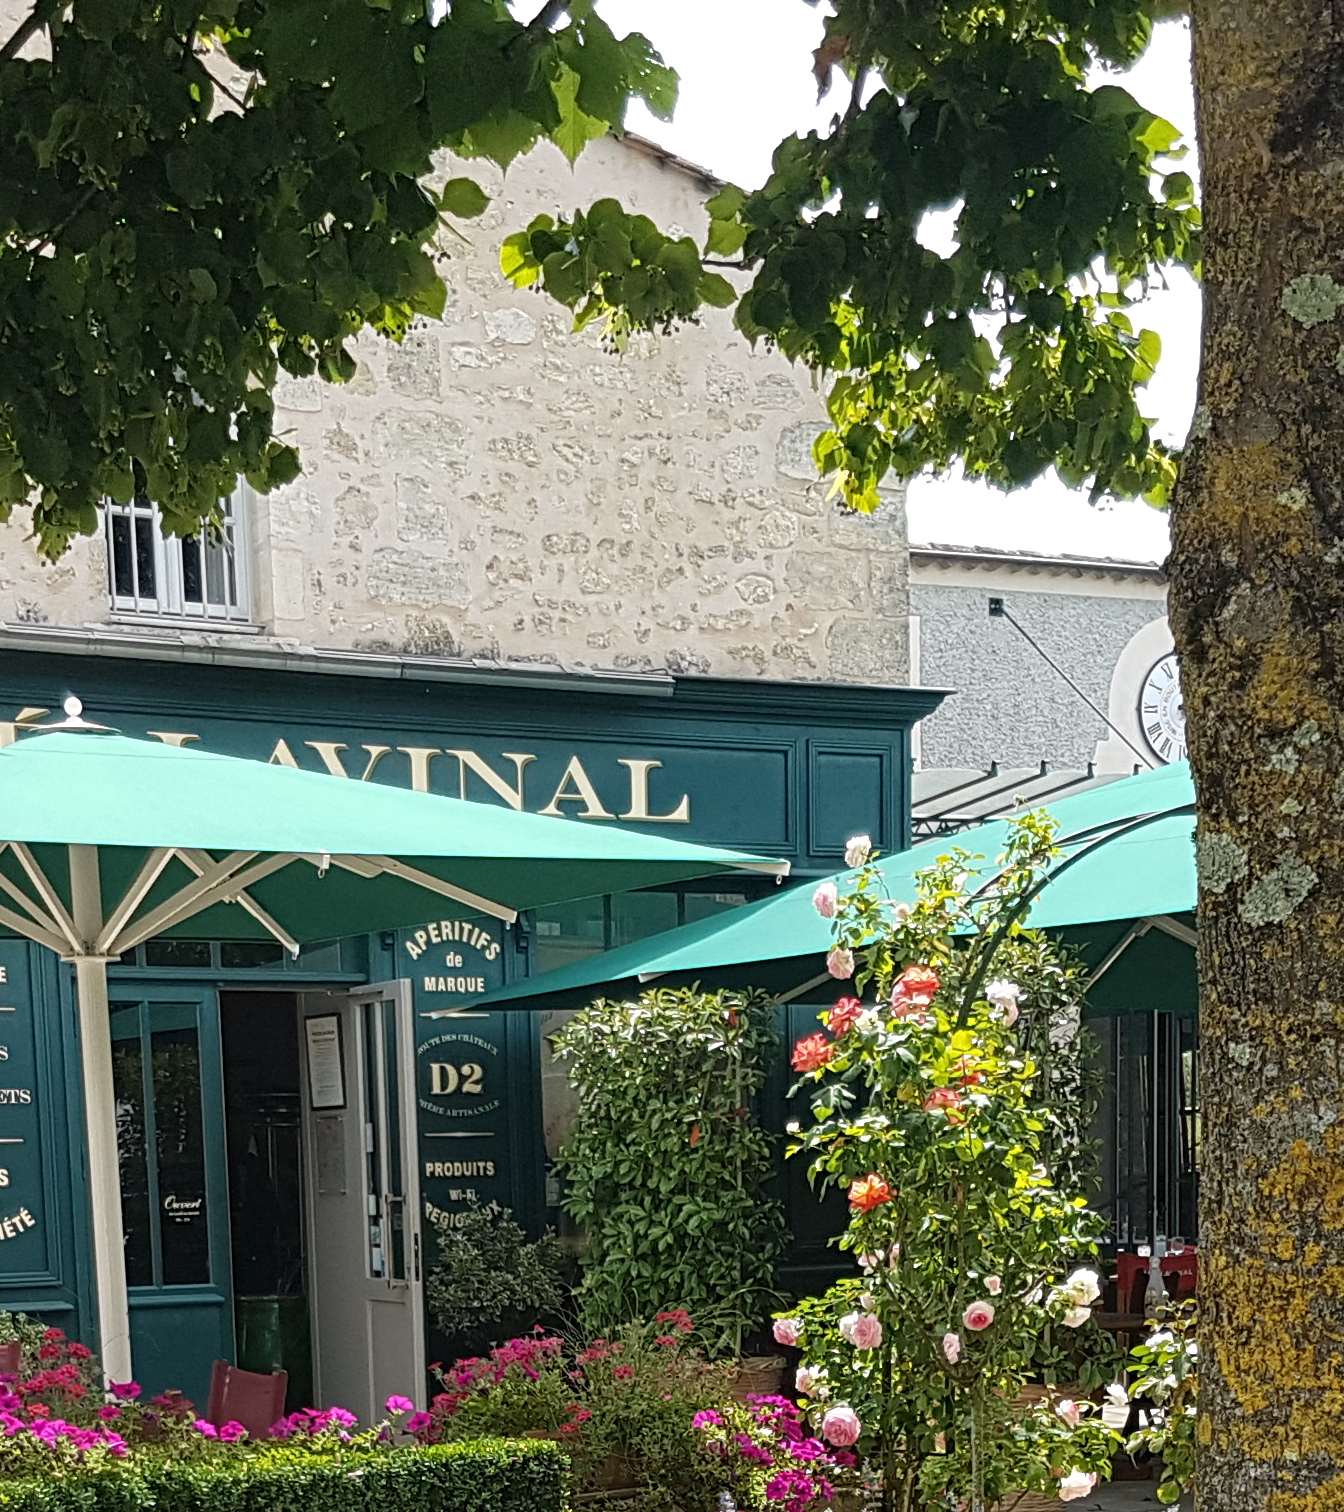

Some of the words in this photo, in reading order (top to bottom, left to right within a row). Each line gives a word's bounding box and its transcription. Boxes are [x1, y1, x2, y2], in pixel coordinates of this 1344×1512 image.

[147, 730, 690, 824] VINAL
[405, 920, 501, 961] APERITIFS
[445, 951, 463, 968] de
[424, 976, 485, 993] MARQUE
[430, 1063, 484, 1095] D2
[425, 1161, 495, 1177] PRODUITS
[449, 1189, 476, 1201] WI-FI
